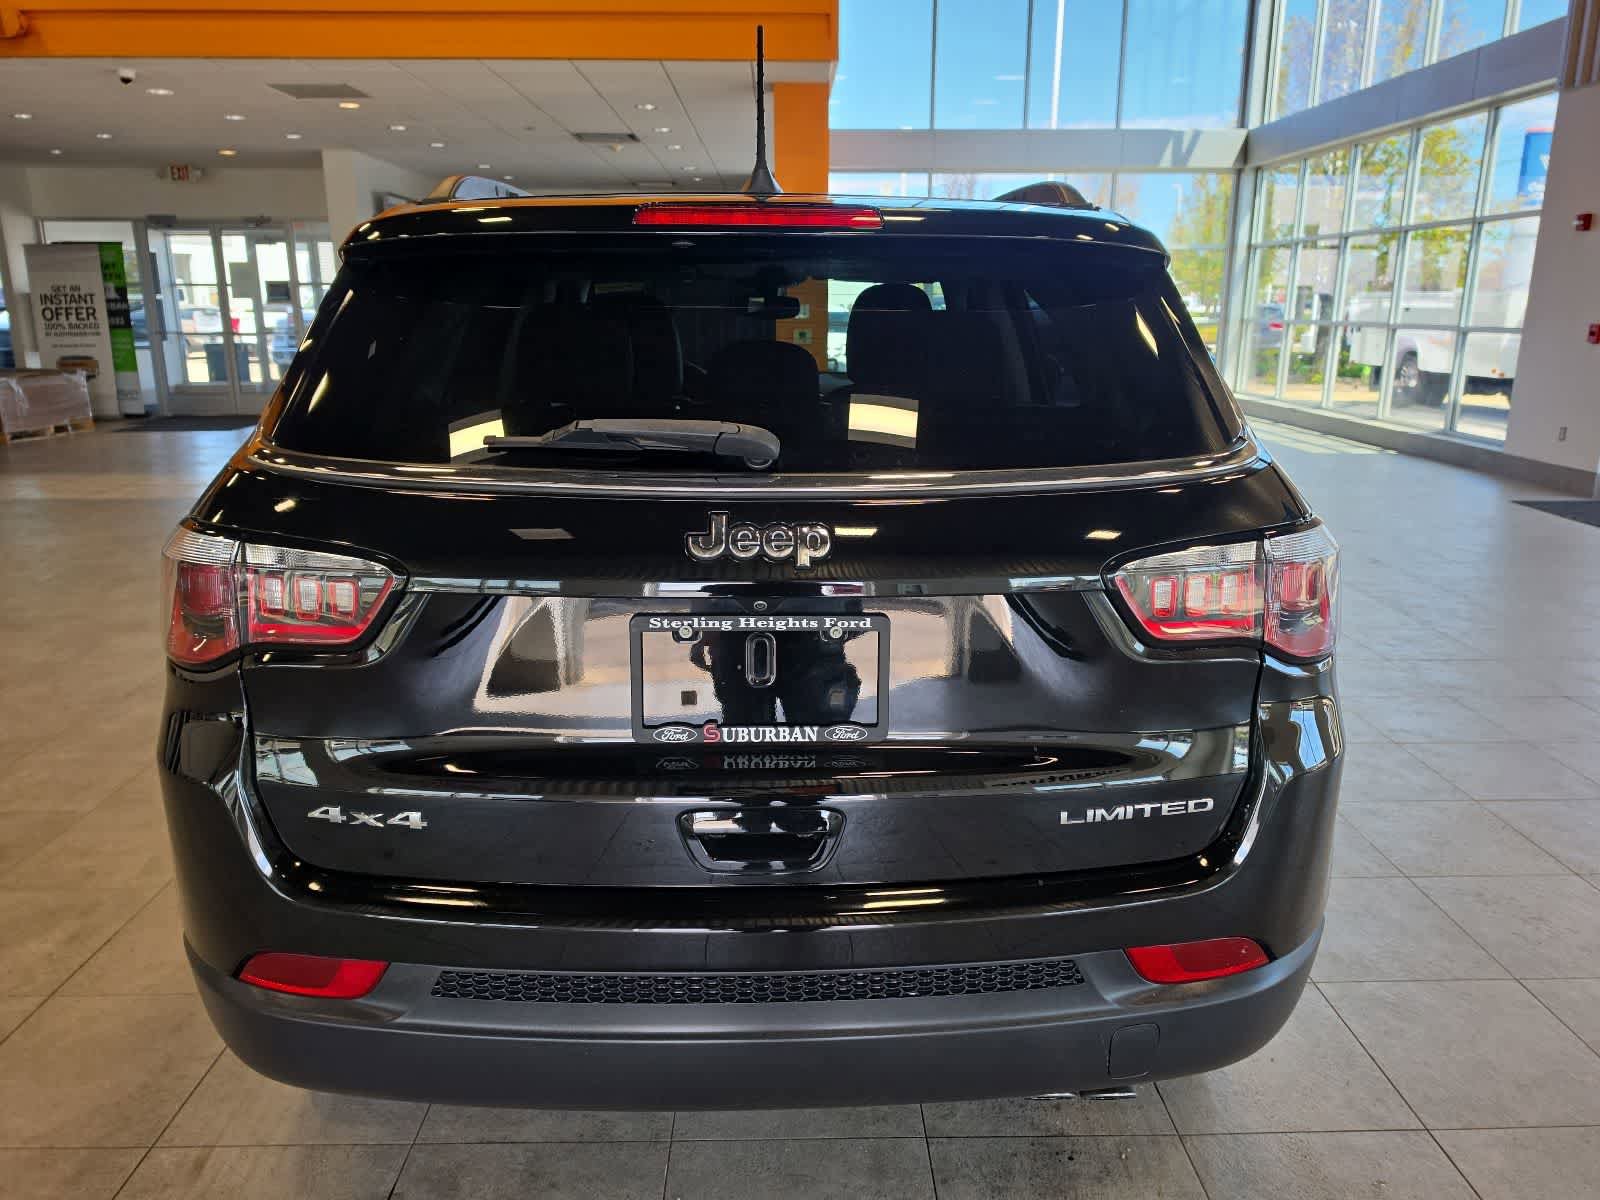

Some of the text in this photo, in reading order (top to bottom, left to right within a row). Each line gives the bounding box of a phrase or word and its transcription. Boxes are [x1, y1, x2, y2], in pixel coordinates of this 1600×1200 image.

[51, 284, 81, 292] GET AN
[40, 293, 95, 305] INSTANT
[41, 306, 97, 321] OFFER
[68, 322, 100, 330] BACKED
[687, 511, 832, 568] Jeep
[648, 617, 873, 631] Sterling Heights Ford
[659, 724, 862, 743] Ford SUBURBAN Ford
[307, 806, 428, 829] 4x4
[1060, 798, 1215, 825] LIMITED
